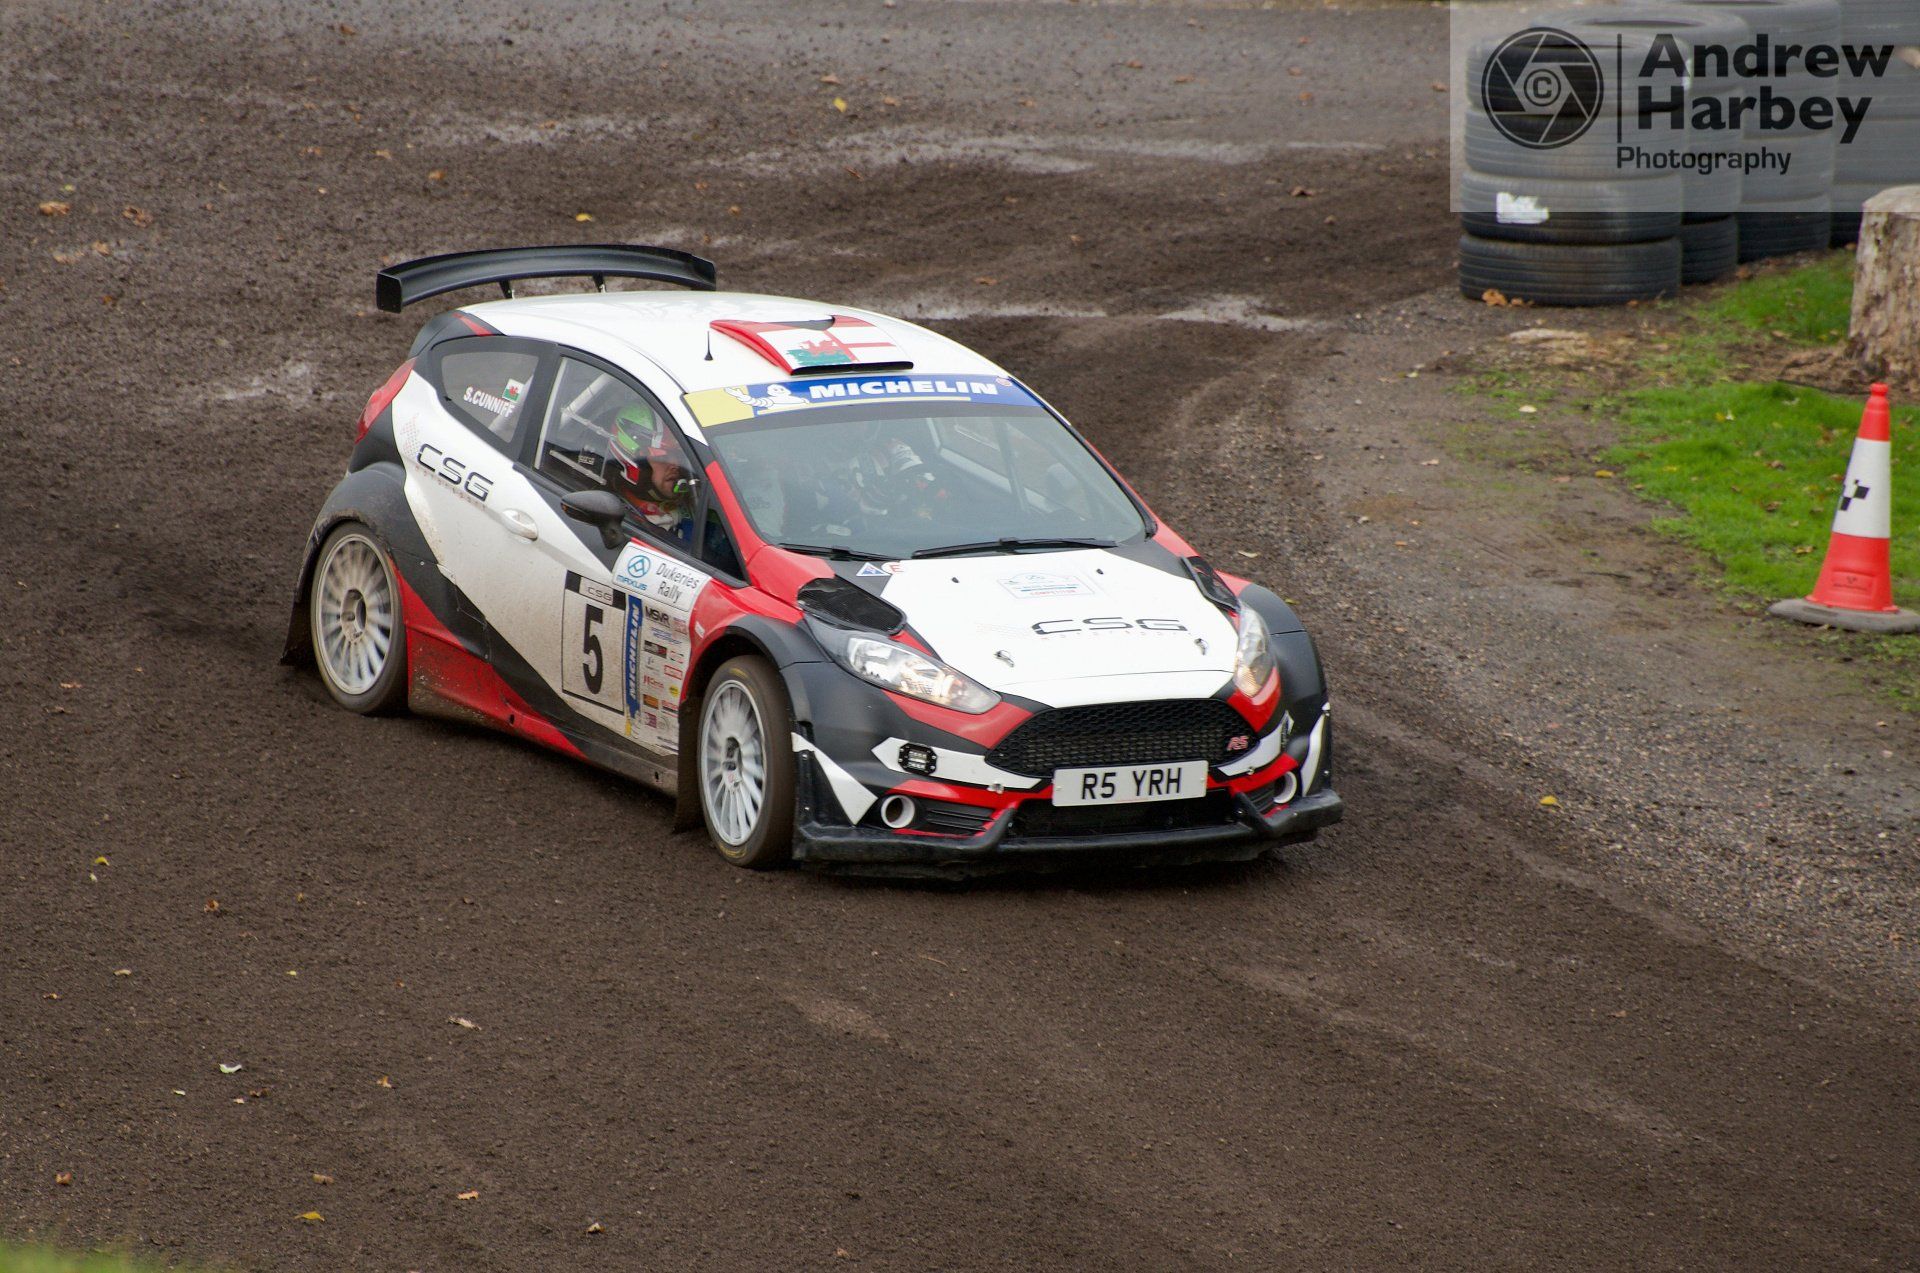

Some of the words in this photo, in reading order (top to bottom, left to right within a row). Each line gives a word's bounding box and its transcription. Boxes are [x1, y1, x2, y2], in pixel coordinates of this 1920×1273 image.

[463, 386, 516, 418] S.CUNNIFF
[809, 380, 999, 399] MICHELIN
[417, 443, 494, 502] CSG
[656, 563, 699, 589] Dukeries
[587, 586, 613, 601] CSG
[657, 581, 683, 604] Rally
[1031, 616, 1189, 636] CSG
[582, 603, 604, 695] 5
[628, 603, 640, 700] MICHELIN
[1081, 771, 1116, 800] R5
[1133, 767, 1182, 797] YRH
